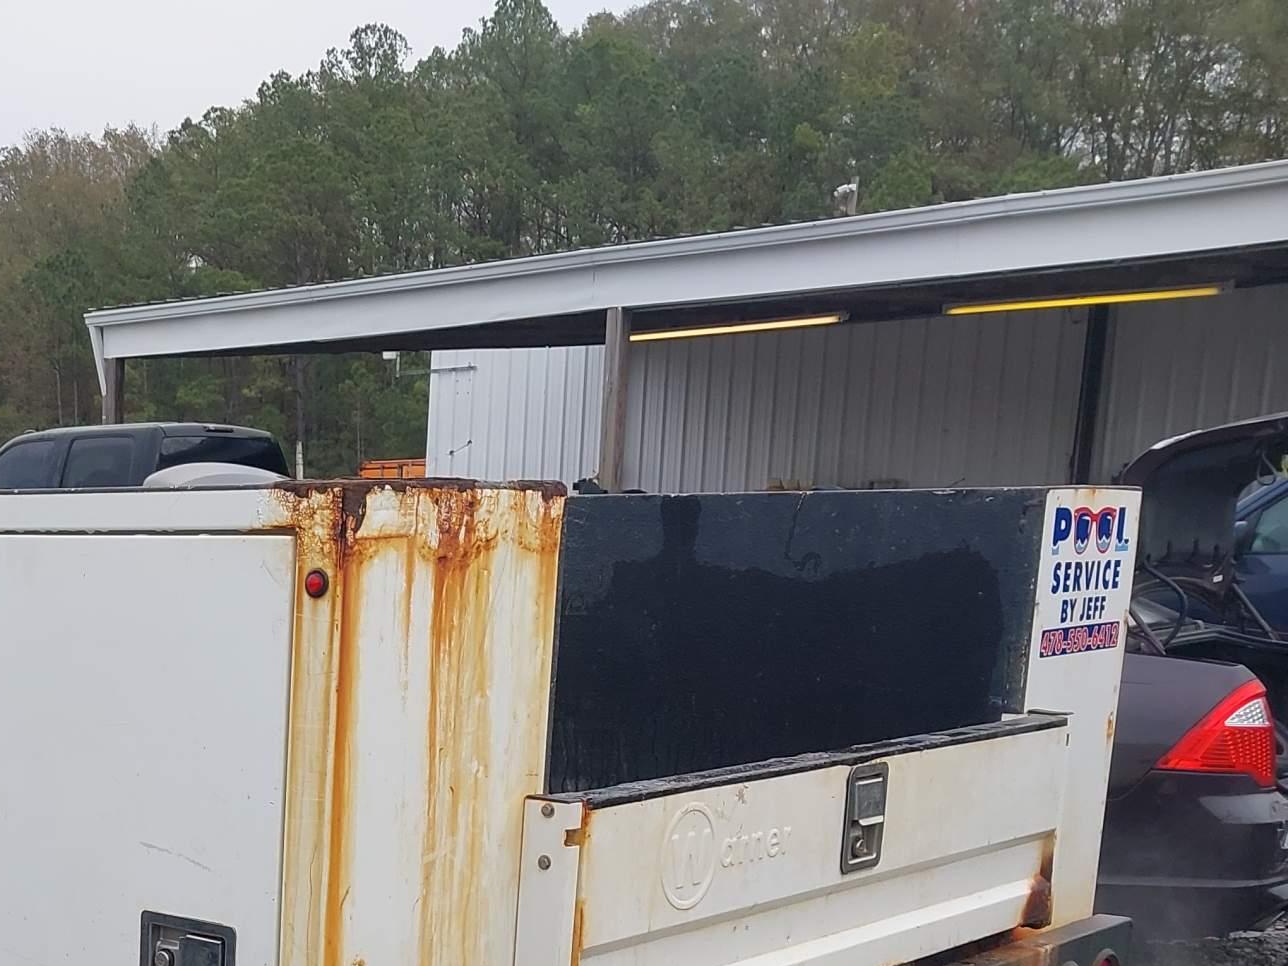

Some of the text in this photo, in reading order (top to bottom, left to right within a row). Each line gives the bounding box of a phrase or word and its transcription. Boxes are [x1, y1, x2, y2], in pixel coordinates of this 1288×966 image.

[1052, 506, 1129, 556] POOL
[1051, 559, 1121, 594] SERVICE
[1061, 595, 1106, 624] BY JEFF
[1041, 622, 1120, 656] 478-550-6412
